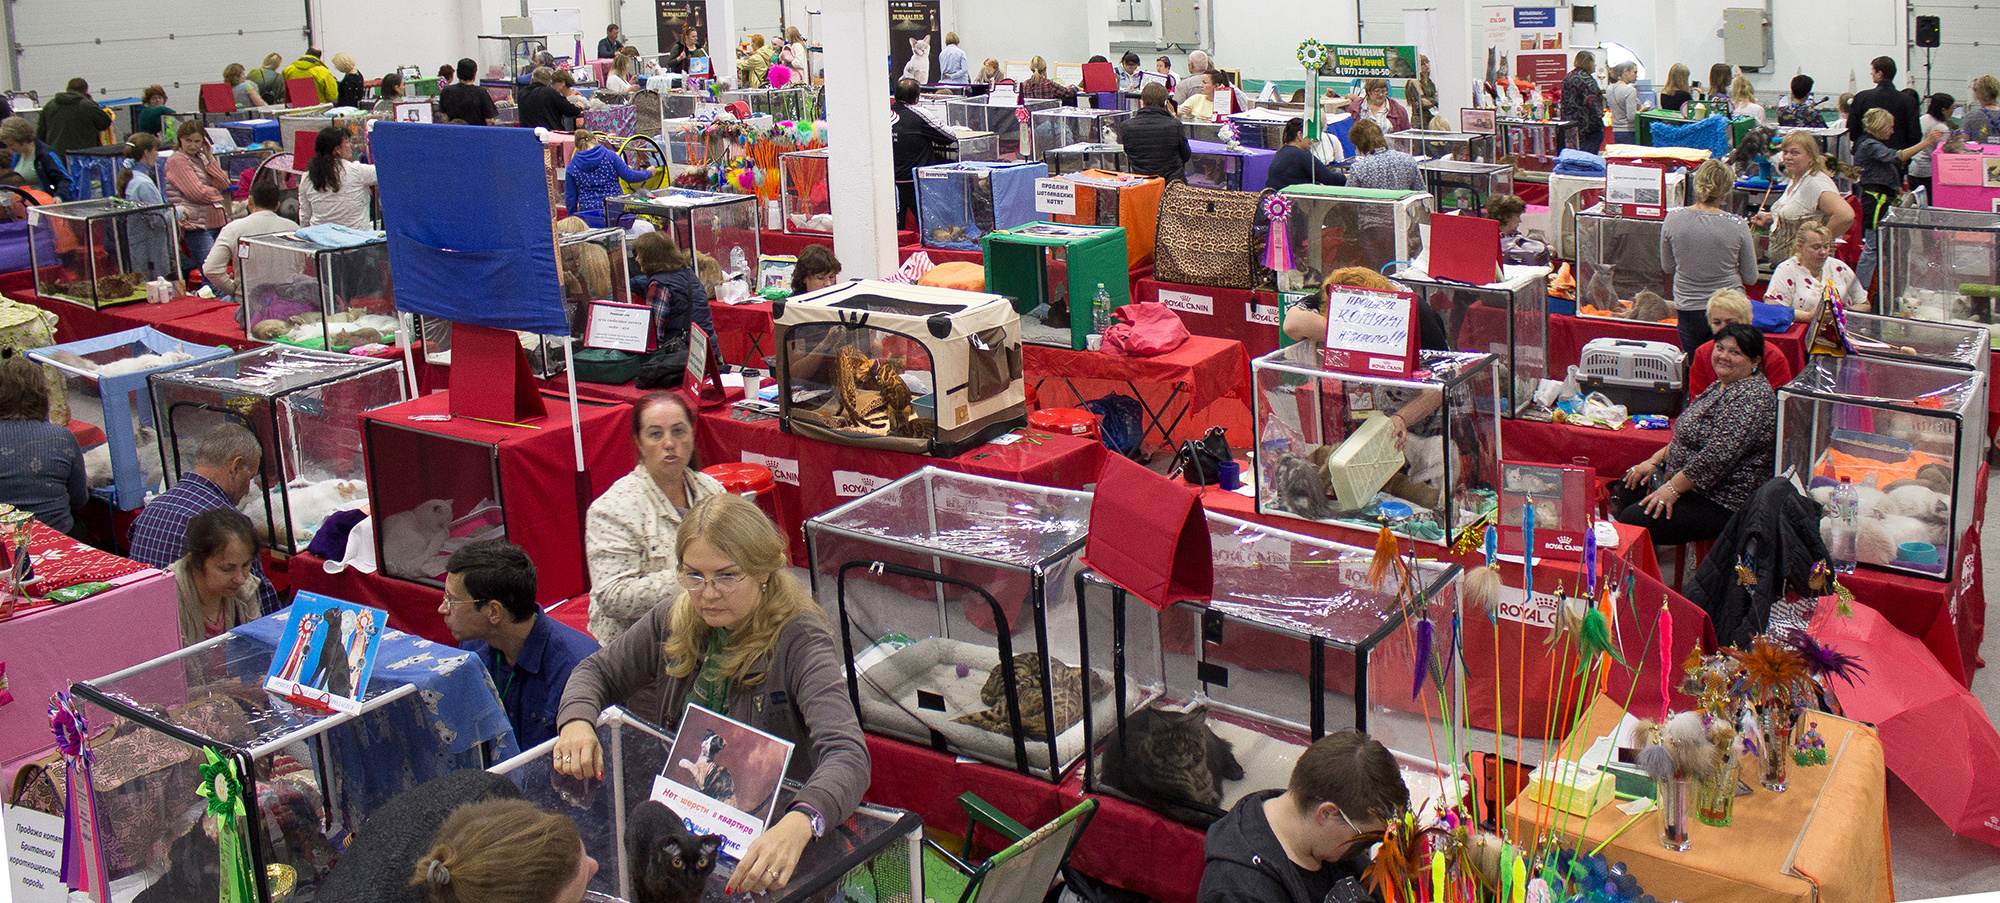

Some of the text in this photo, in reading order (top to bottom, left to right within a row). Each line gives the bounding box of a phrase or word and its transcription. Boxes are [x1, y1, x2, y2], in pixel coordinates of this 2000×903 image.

[1337, 47, 1385, 57] ПИТОМНИК
[1339, 56, 1385, 67] Royal Jewel
[1336, 67, 1340, 75] 8
[1341, 67, 1357, 75] (977)
[1164, 299, 1209, 312] ROYAL CANIN
[1251, 313, 1272, 323] ROYAL
[774, 470, 799, 482] CANIN
[843, 484, 868, 494] ROYAL
[1545, 542, 1584, 552] ROYAL CANIN
[1500, 603, 1544, 624] ROYAL
[662, 788, 678, 801] Нет
[680, 797, 709, 814] шерсти
[718, 814, 754, 835] квартире
[15, 823, 42, 838] Продажа
[20, 841, 56, 858] Британской
[22, 877, 45, 890] породы.
